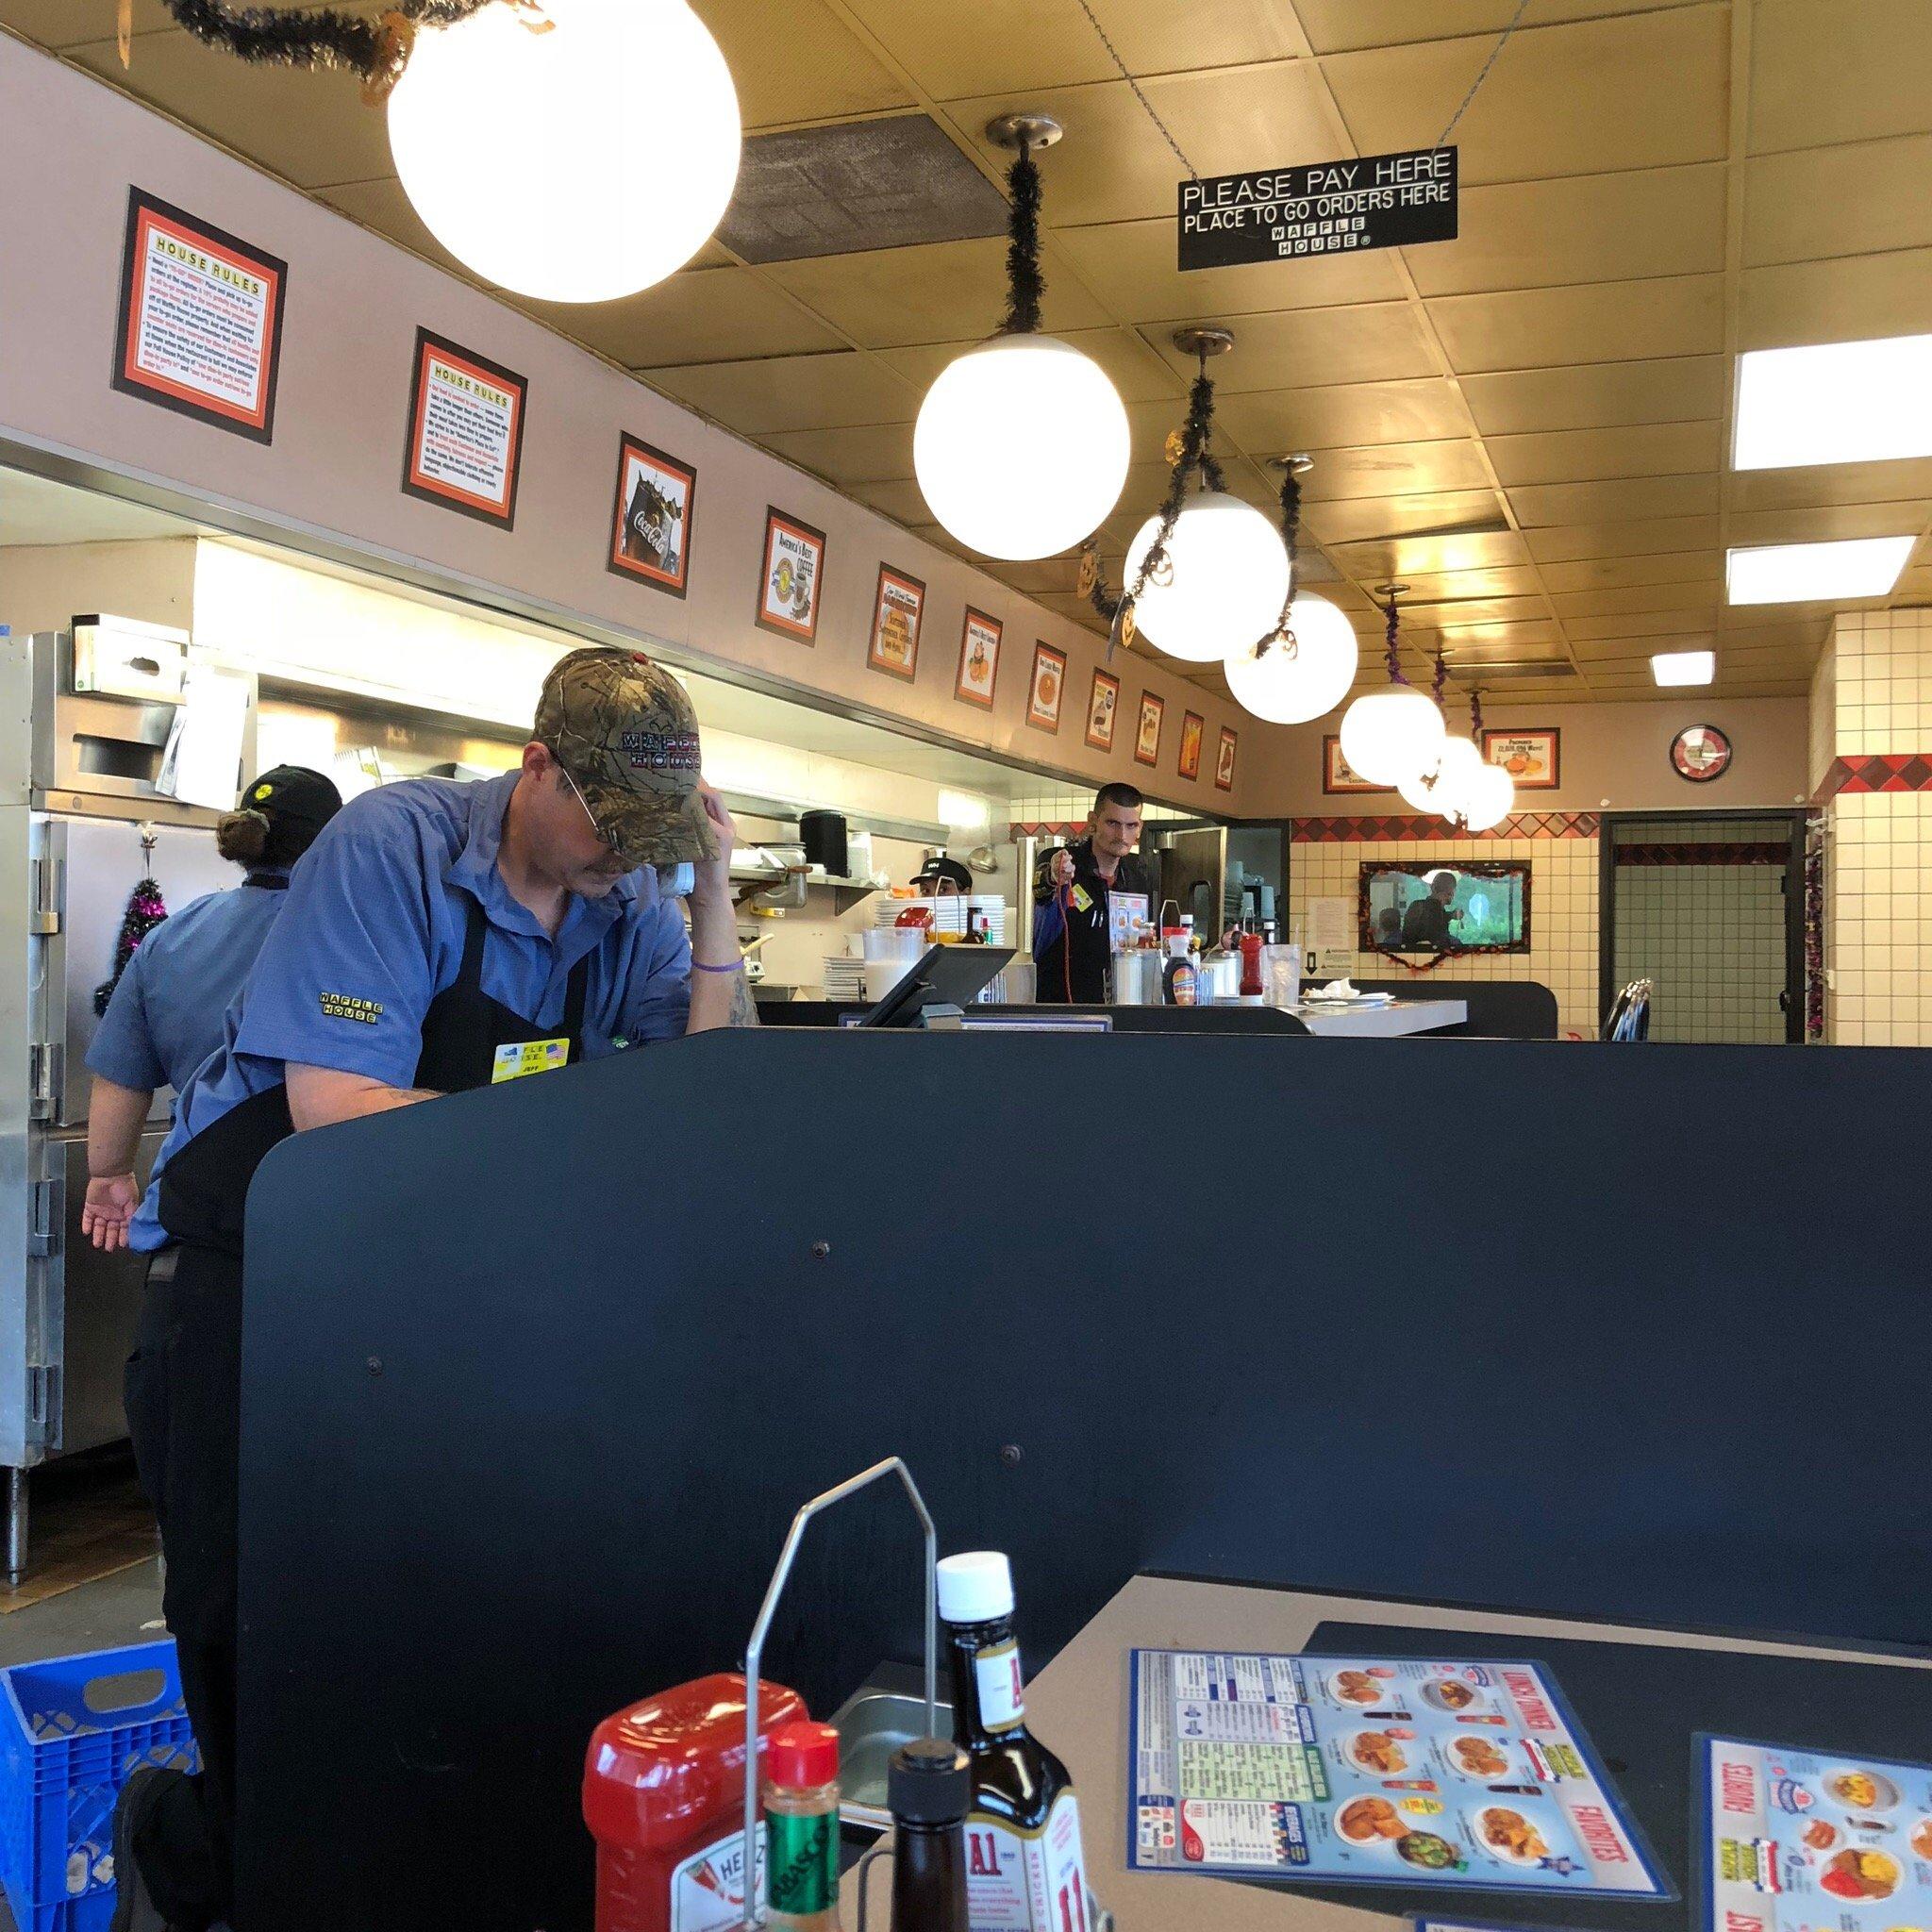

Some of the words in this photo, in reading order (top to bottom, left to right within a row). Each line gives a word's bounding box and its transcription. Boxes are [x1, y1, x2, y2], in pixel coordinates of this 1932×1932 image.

[1184, 174, 1291, 209] PLEASE
[1307, 165, 1358, 193] PAY
[1375, 153, 1451, 185] HERE
[1185, 208, 1245, 233] PLACE
[1252, 206, 1276, 225] TO
[1284, 199, 1309, 221] GO
[1317, 190, 1393, 217] ORDERS
[1401, 182, 1451, 208] HERE
[1272, 217, 1365, 241] WAFFLE
[155, 235, 207, 271] HOUSE
[211, 263, 261, 296] RULES
[434, 365, 471, 391] HOUSE
[475, 383, 508, 408] RULES
[319, 991, 383, 1014] WAFFLE
[324, 1005, 376, 1024] HOUSE
[720, 1844, 765, 1881] HEZ
